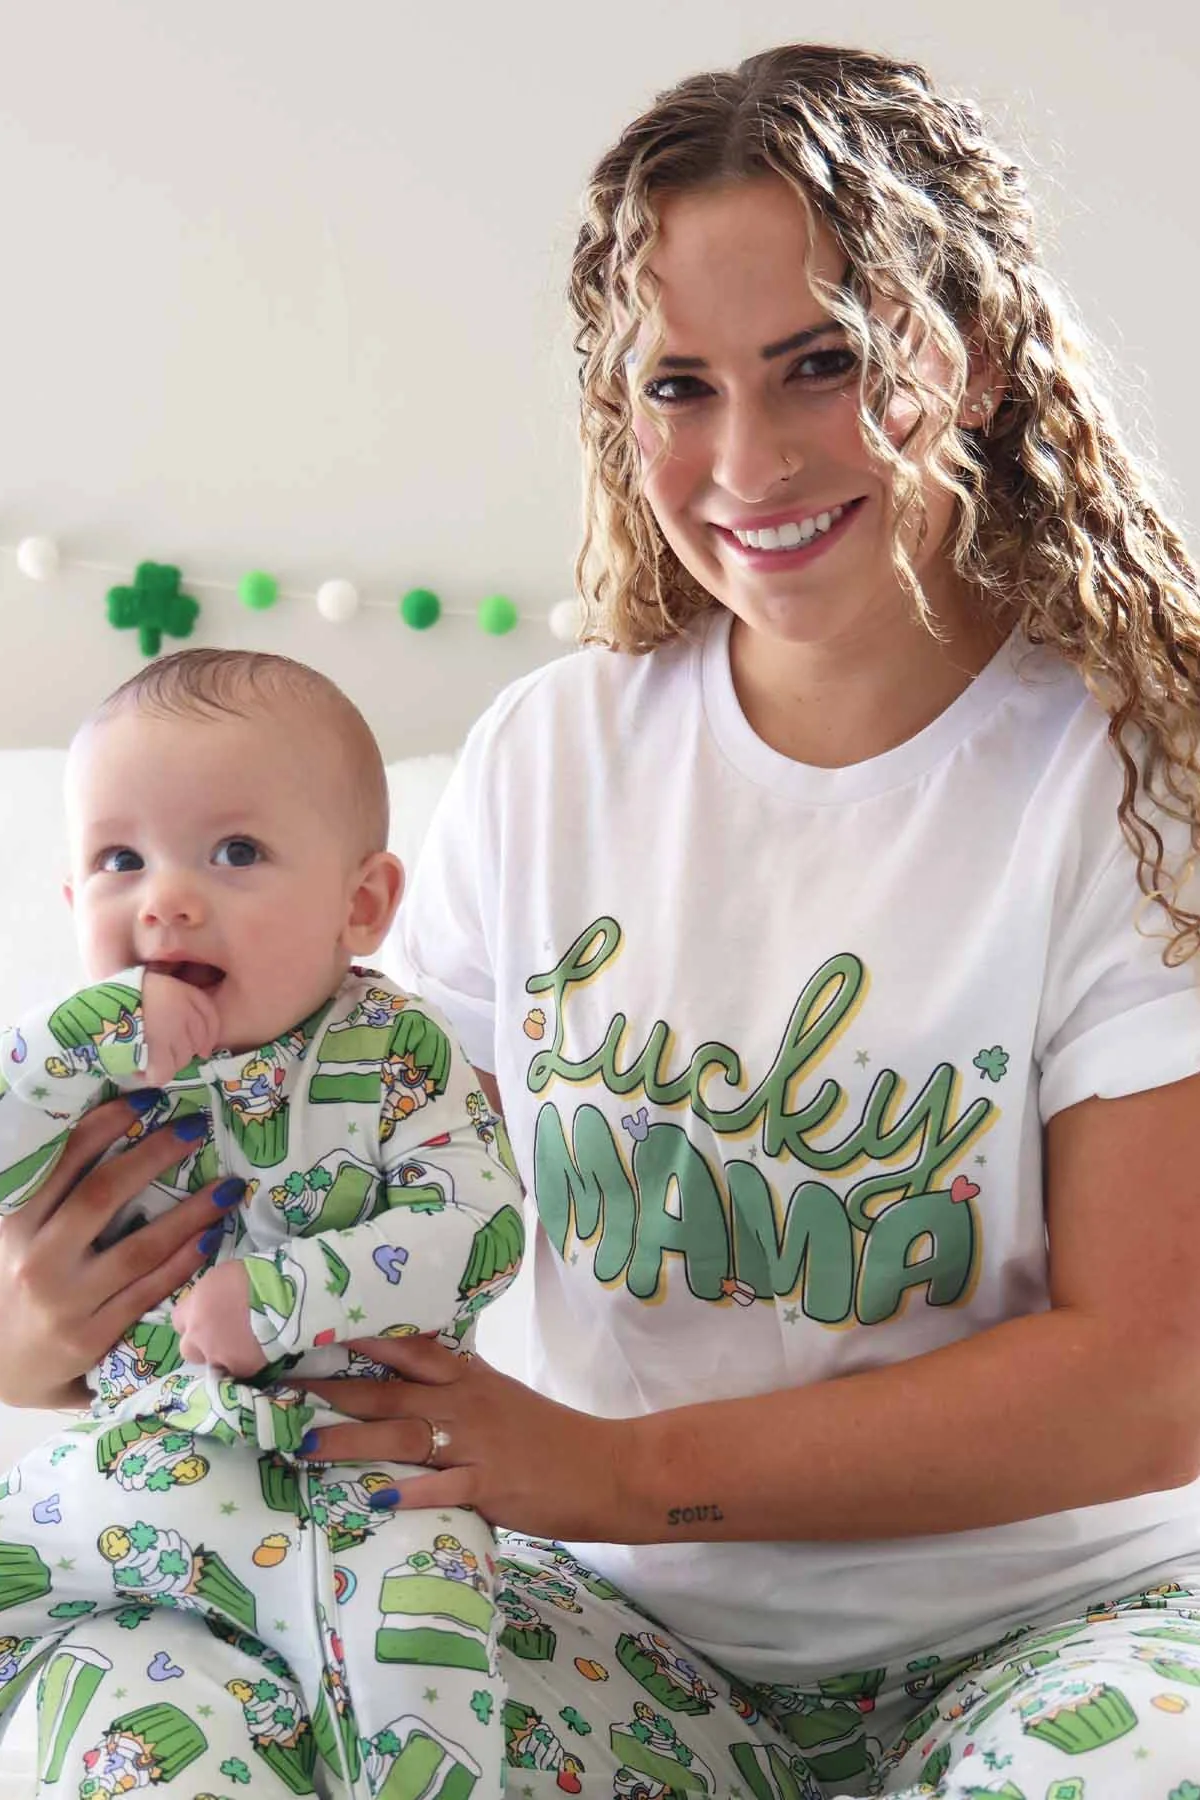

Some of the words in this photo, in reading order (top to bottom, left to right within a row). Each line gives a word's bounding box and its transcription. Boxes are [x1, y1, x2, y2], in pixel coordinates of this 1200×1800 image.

[525, 916, 993, 1234] Lucky
[533, 1102, 977, 1326] MAMA
[667, 1505, 724, 1526] SOUL
